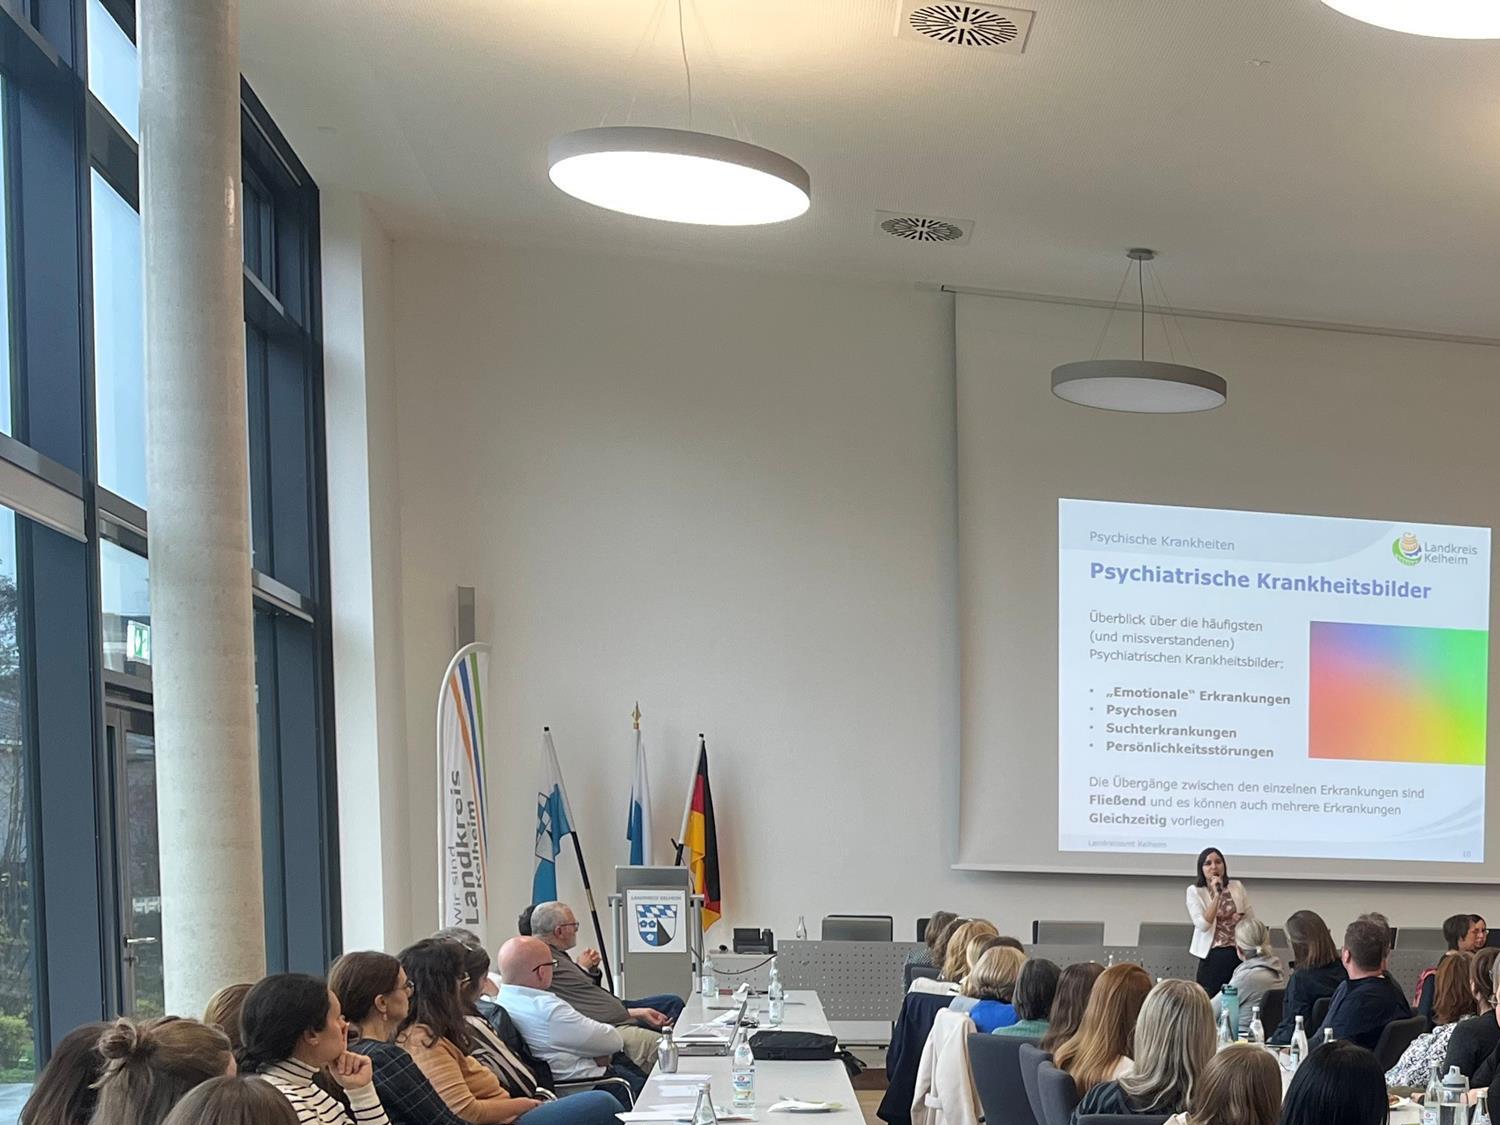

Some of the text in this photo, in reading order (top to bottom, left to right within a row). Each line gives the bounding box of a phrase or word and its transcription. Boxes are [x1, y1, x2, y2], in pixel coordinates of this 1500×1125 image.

[1090, 531, 1235, 551] Psychische Krankheiten
[1424, 542, 1478, 555] Landkreis
[1424, 553, 1468, 565] Kelheim
[1090, 562, 1431, 599] Psychiatrische Krankheitsbilder
[1089, 609, 1263, 633] Überblick über die häufigsten
[1090, 630, 1235, 651] (und missverstandenen)
[1090, 649, 1284, 669] Psychiatrischen Krankheitsbilder:
[1200, 691, 1291, 707] Erkrankungen
[1106, 704, 1177, 718] Psychosen
[1106, 723, 1237, 740] Suchterkrankungen
[1106, 741, 1274, 759] Persönlichkeitsstörungen
[1089, 775, 1425, 800] Die Übergänge zwischen den einzelnen Erkrankungen sind
[1089, 795, 1402, 817] Fließend und es können auch mehrere Erkrankungen
[1089, 813, 1225, 829] Gleichzeitig vorliegen
[451, 770, 480, 925] Landkreis
[466, 801, 482, 888] Kelheim
[448, 846, 459, 886] sind
